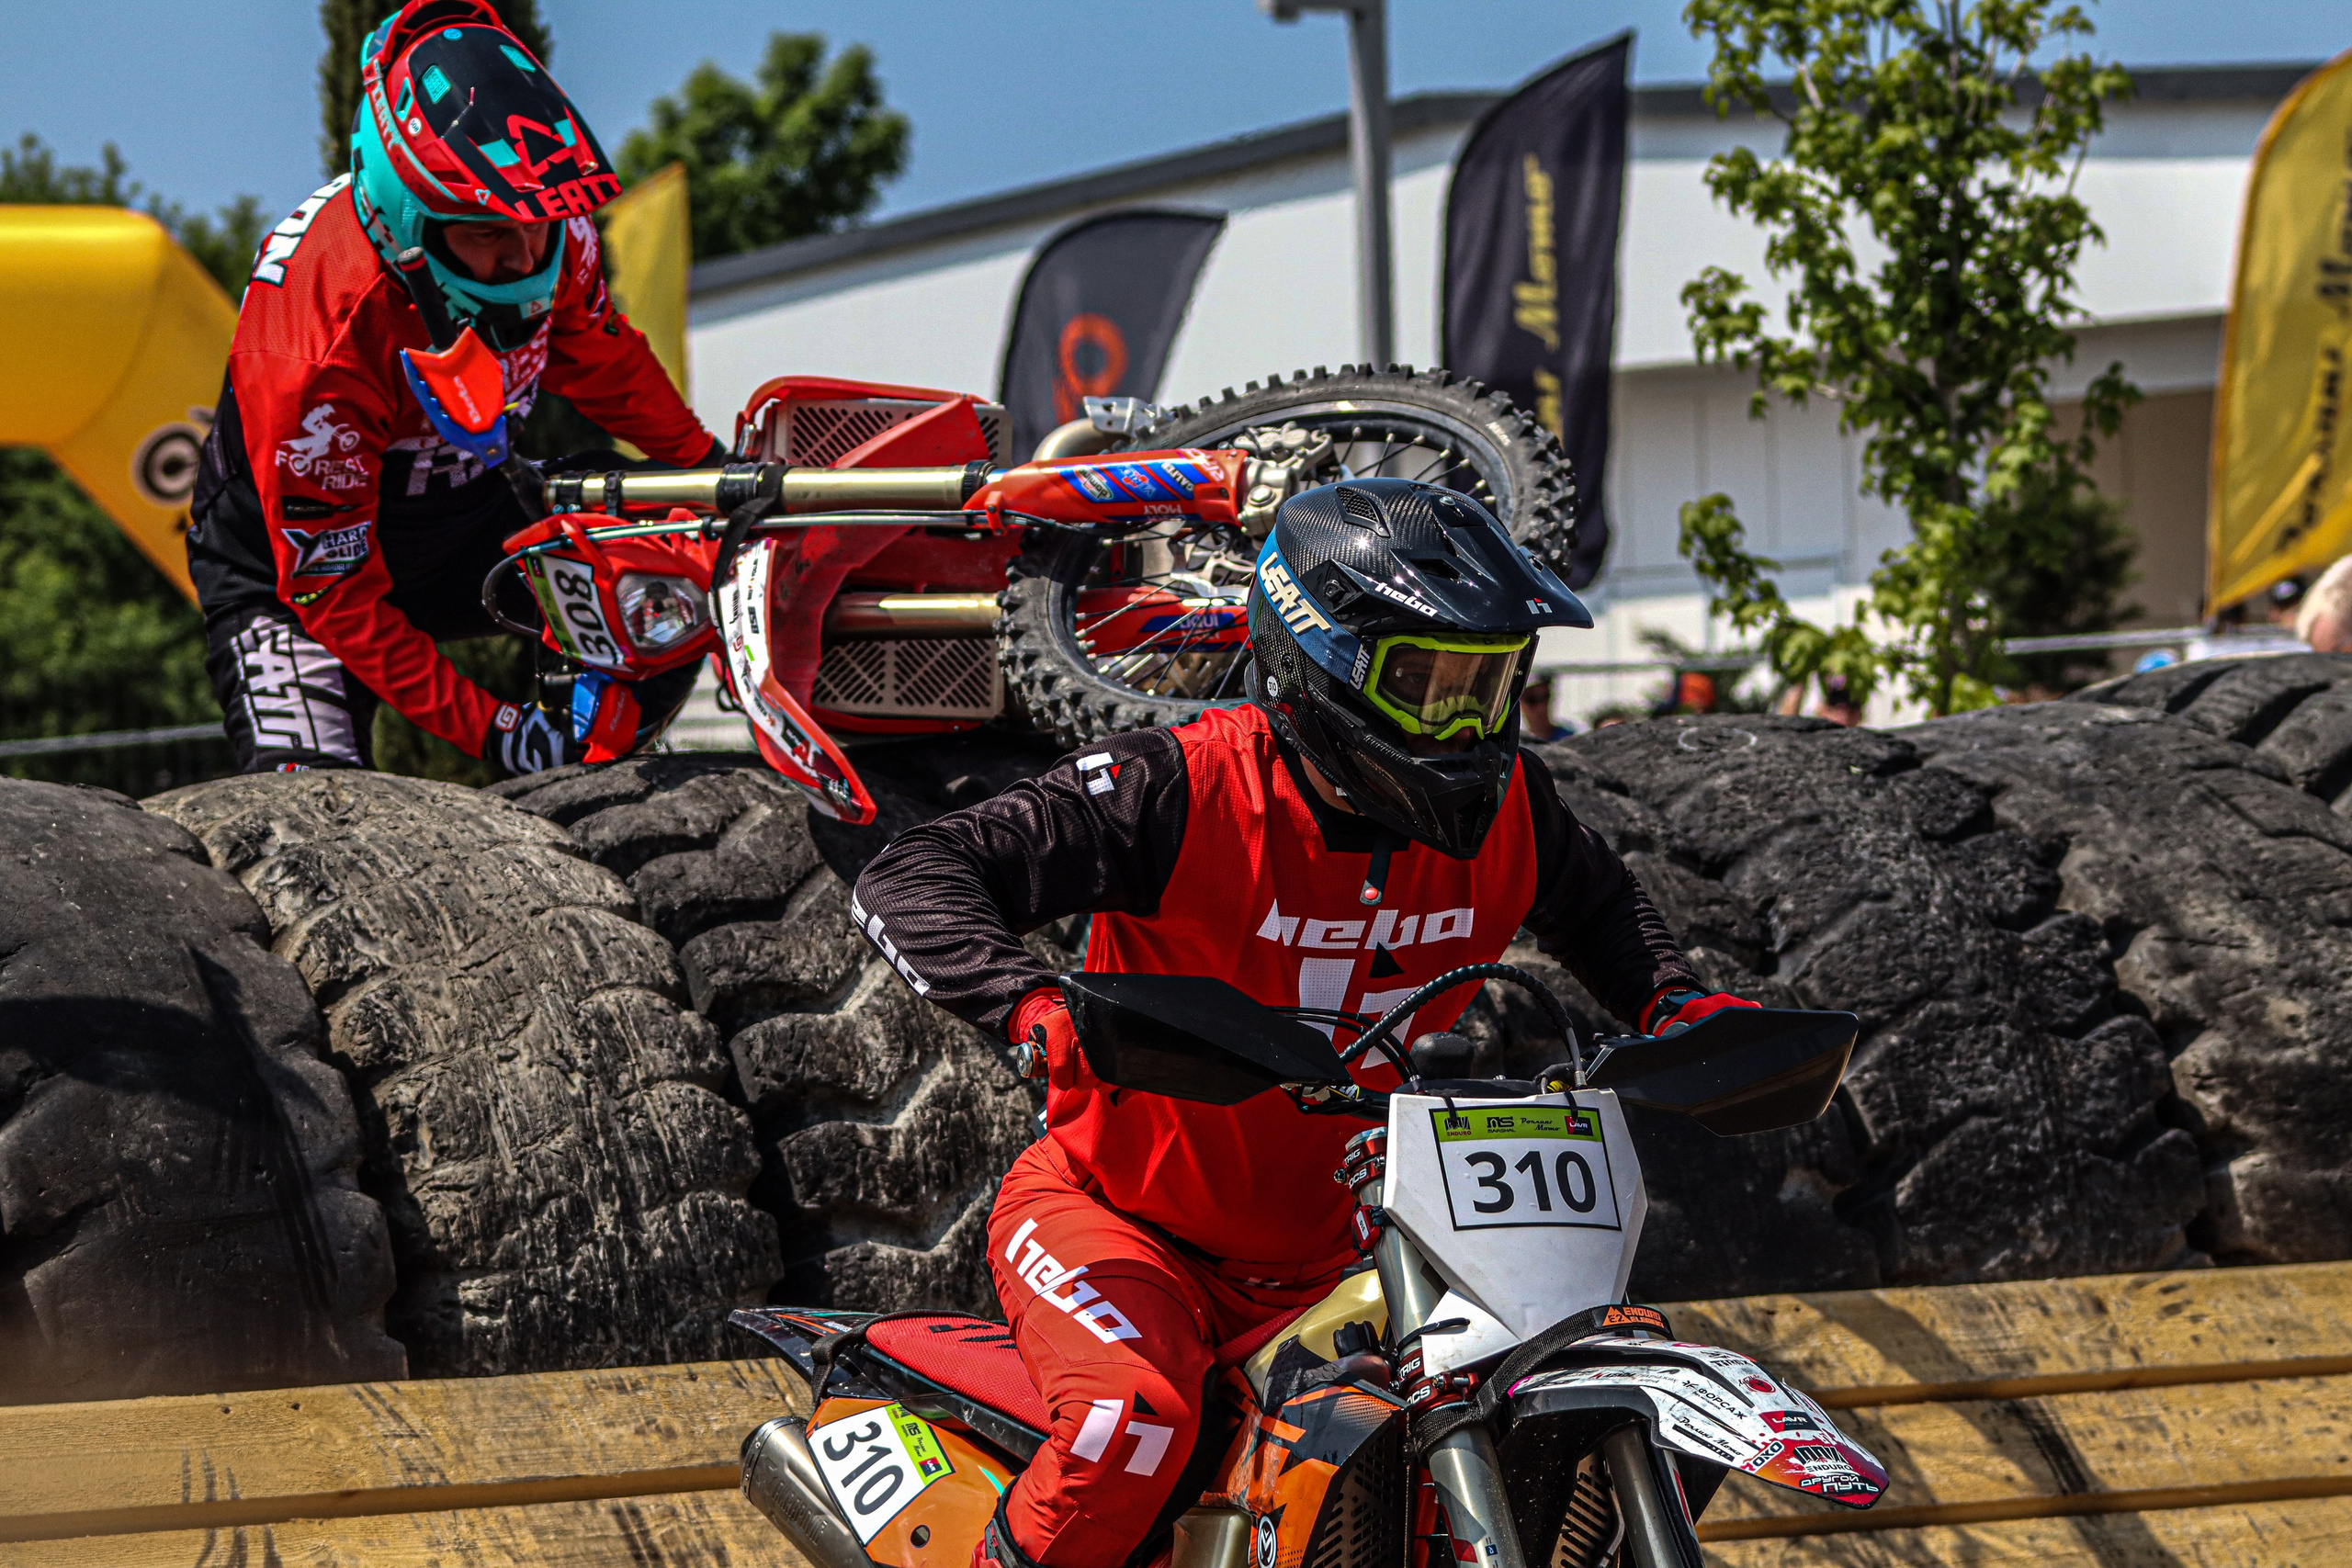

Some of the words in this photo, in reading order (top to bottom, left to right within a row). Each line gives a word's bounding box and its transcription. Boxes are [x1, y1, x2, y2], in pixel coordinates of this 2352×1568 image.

[514, 174, 619, 220] LEATT
[322, 471, 368, 491] RIDE
[1144, 504, 1182, 514] MOLY
[322, 527, 368, 549] HARD
[1260, 551, 1332, 635] LEATT
[1374, 581, 1439, 618] hebo
[554, 569, 618, 666] 308
[1350, 644, 1372, 690] LEATT
[1267, 679, 1278, 692] 310
[1256, 898, 1474, 950] hebo
[1464, 1150, 1597, 1213] 310
[1004, 1218, 1143, 1345] hebo
[1698, 1387, 1747, 1420] ФОРСАЖ
[1772, 1416, 1808, 1425] LAVR
[822, 1420, 904, 1516] 310
[1801, 1474, 1860, 1487] ДРУГОЙ
[1805, 1464, 1854, 1472] ENDURO
[1823, 1482, 1880, 1493] ПУТЬ
